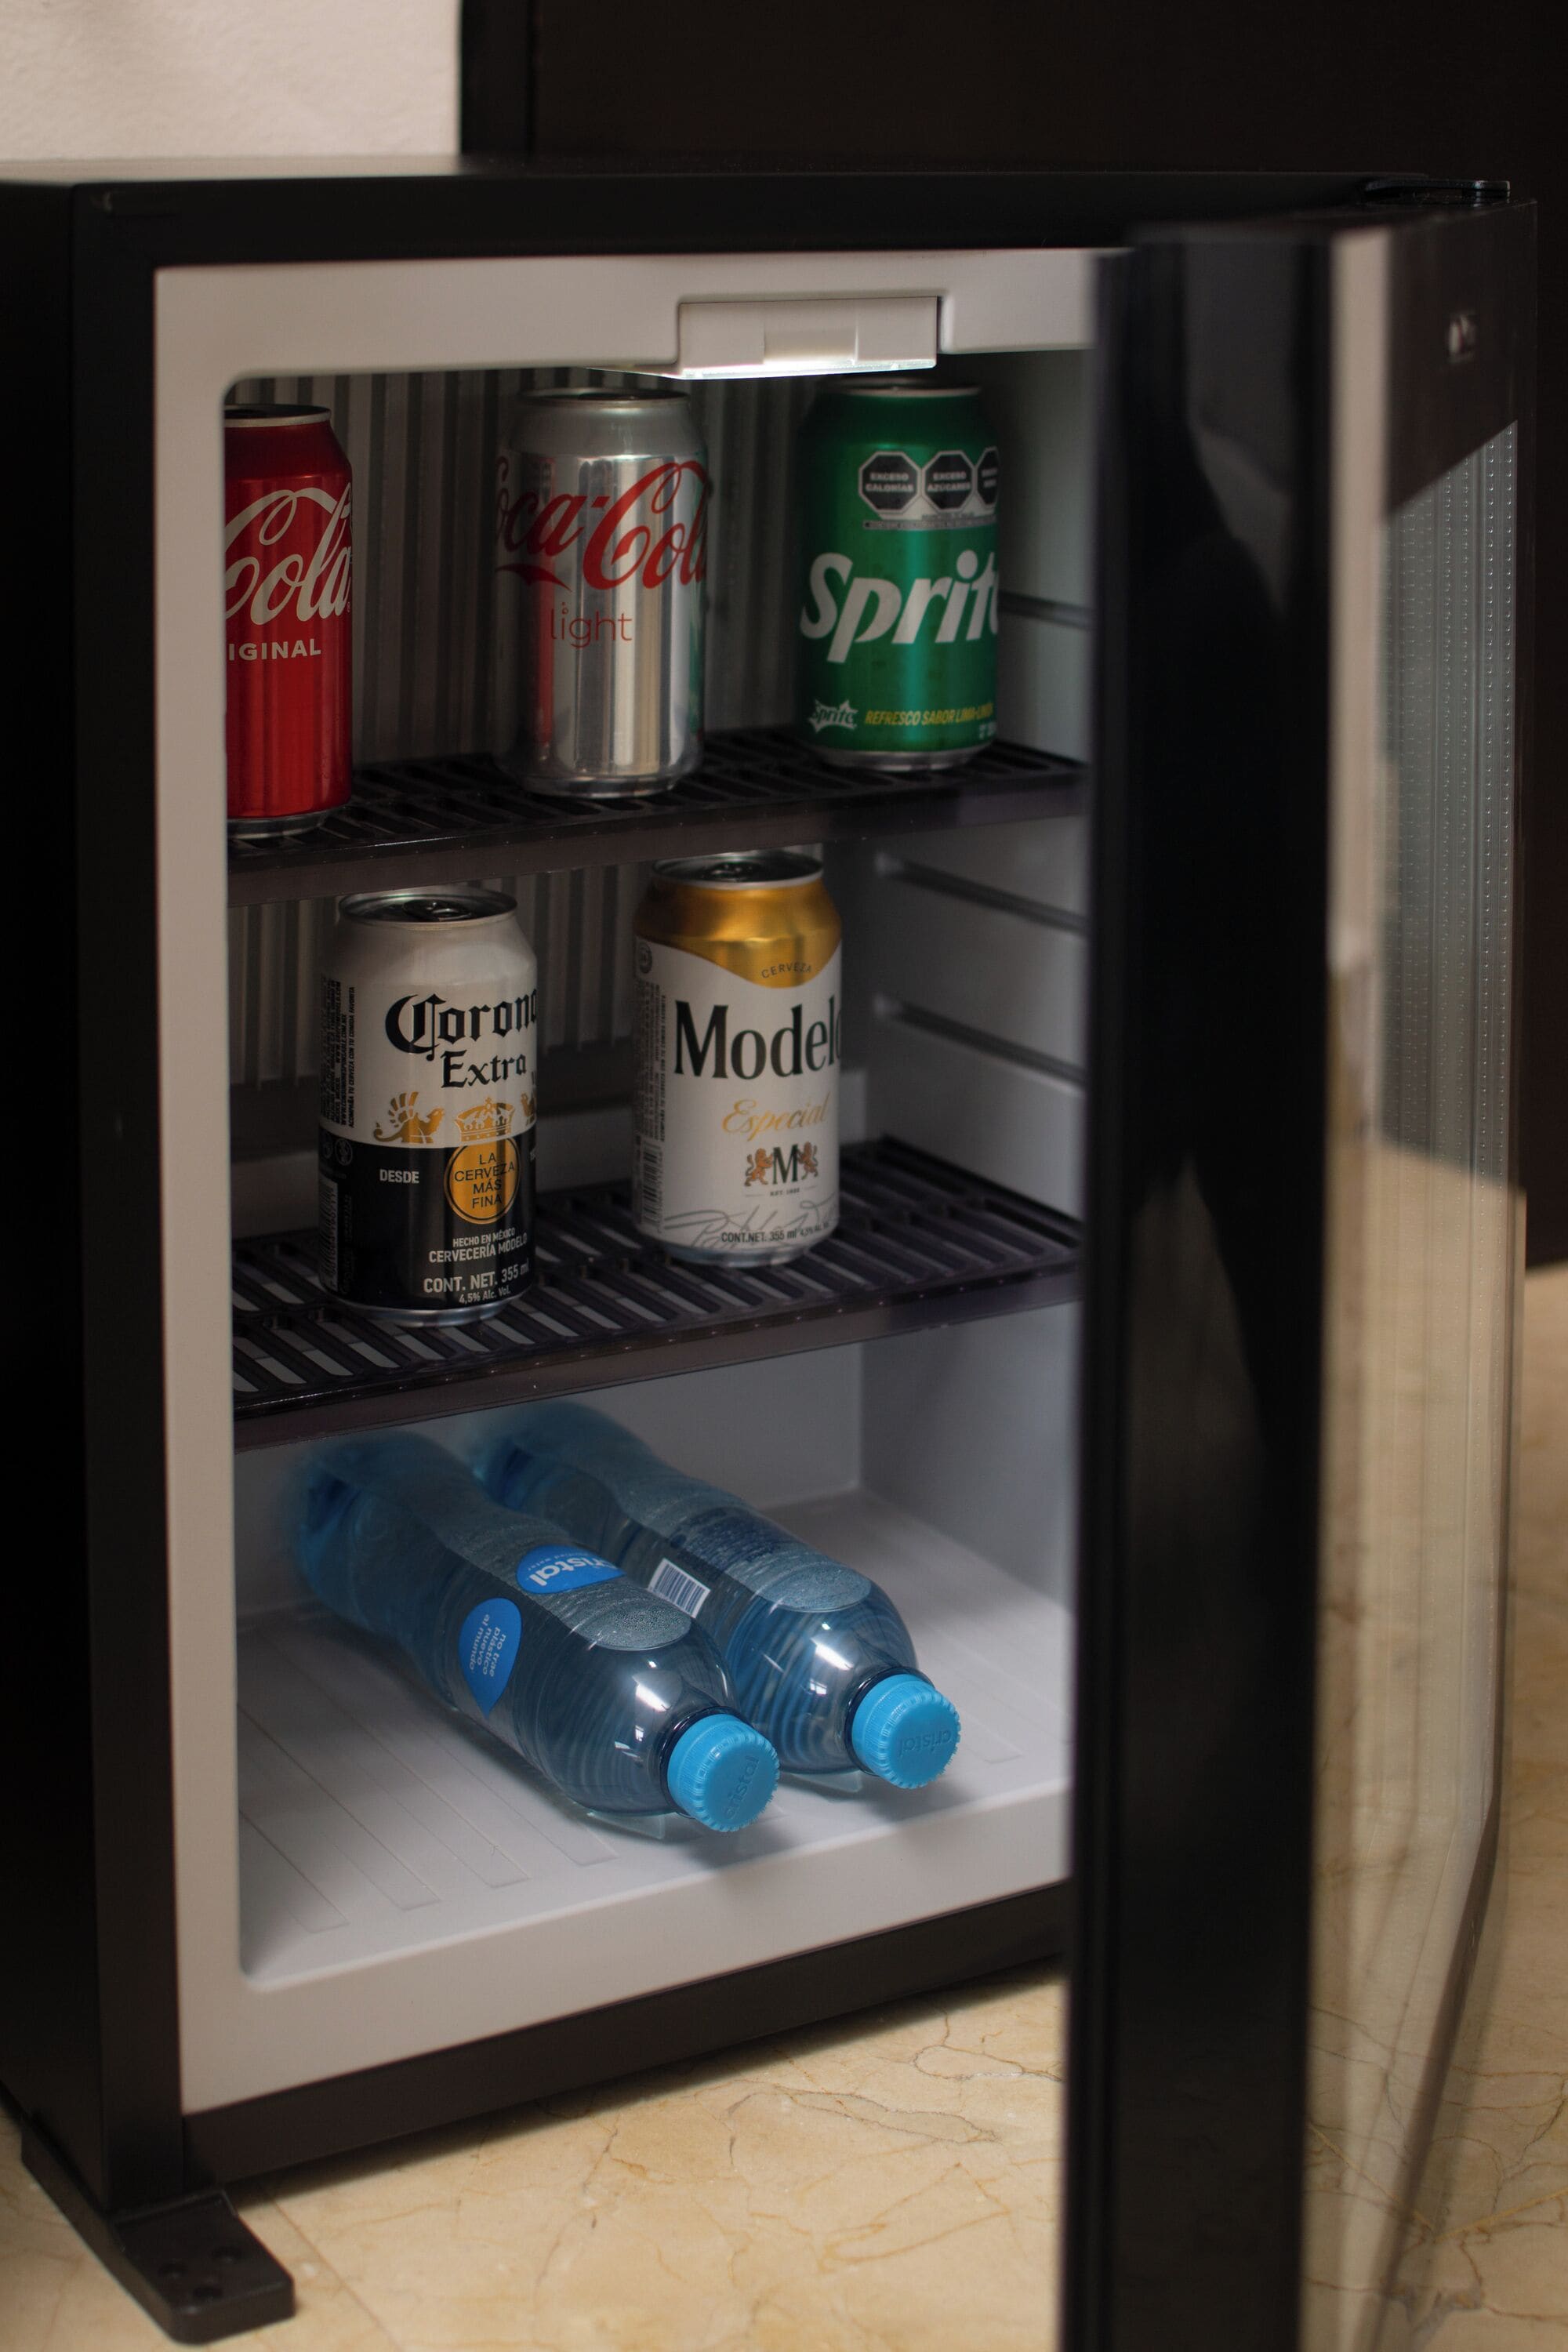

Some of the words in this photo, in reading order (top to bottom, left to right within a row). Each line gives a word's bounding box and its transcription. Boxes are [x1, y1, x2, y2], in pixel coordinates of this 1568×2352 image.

[496, 456, 707, 590] oca-Col
[799, 549, 999, 664] Sprit
[550, 601, 633, 649] light
[228, 638, 321, 661] IGINAL
[865, 710, 921, 726] REFRESCO
[921, 709, 955, 725] SABOR
[761, 961, 812, 978] CERVEZA
[440, 1049, 527, 1088] Extra
[721, 1091, 831, 1142] Especial
[454, 1161, 516, 1182] CERVEZA
[478, 1152, 497, 1166] LA
[772, 1144, 799, 1185] M
[379, 1168, 420, 1184] DESDE
[473, 1178, 503, 1195] MÁS
[471, 1194, 503, 1209] FINA
[428, 1243, 497, 1264] CERVECERÍA
[498, 1232, 528, 1254] MODELO
[452, 1236, 480, 1248] HECHO
[481, 1233, 492, 1244] EN
[492, 1227, 516, 1243] MÉXICO
[423, 1276, 466, 1294] CONT.
[470, 1271, 498, 1290] NET.
[501, 1264, 519, 1283] 355
[458, 1292, 481, 1305] 4,5%
[482, 1289, 497, 1301] Alc.
[482, 1613, 490, 1626] al
[469, 1627, 484, 1671] mundo
[477, 1628, 492, 1666] nuevo
[482, 1626, 501, 1675] plástico
[496, 1633, 507, 1650] no
[489, 1652, 500, 1677] trae
[896, 1728, 953, 1757] cristal
[721, 1755, 760, 1820] cristal
